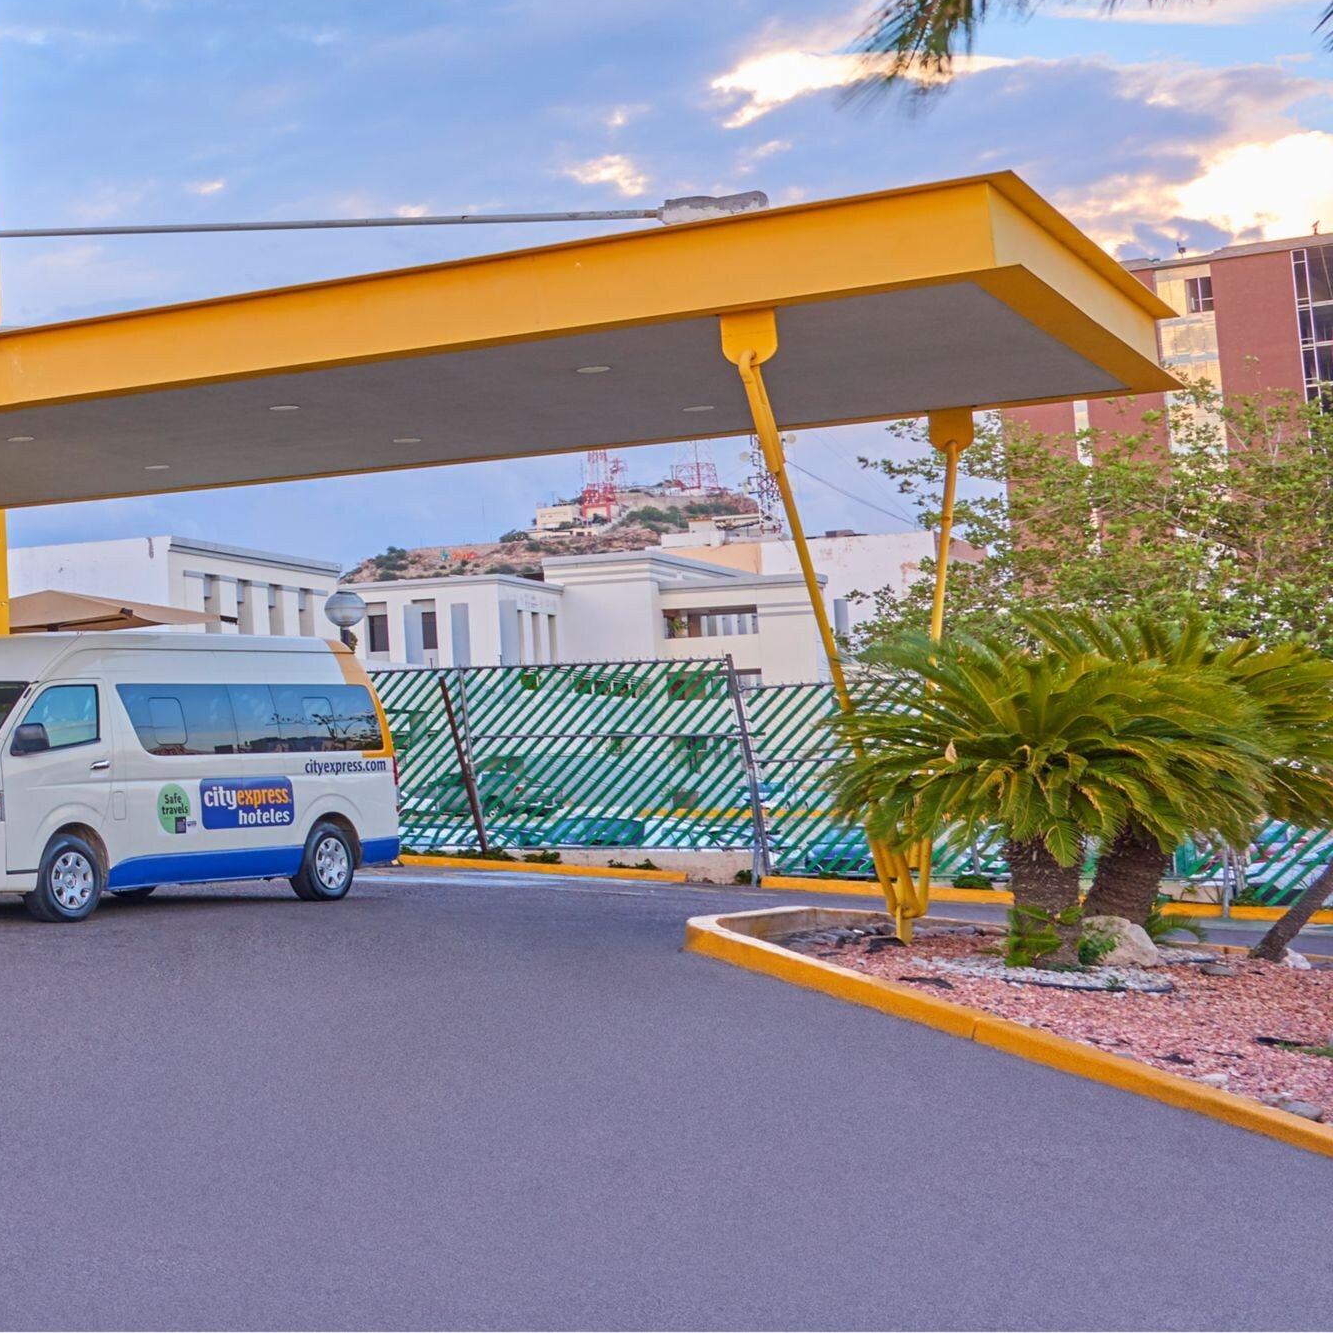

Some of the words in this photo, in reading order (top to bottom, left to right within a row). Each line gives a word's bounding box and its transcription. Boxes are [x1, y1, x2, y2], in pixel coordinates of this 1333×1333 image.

[304, 759, 387, 776] cityexpress.com
[164, 792, 182, 804] Safe
[161, 803, 189, 815] travels
[238, 808, 290, 825] hoteles
